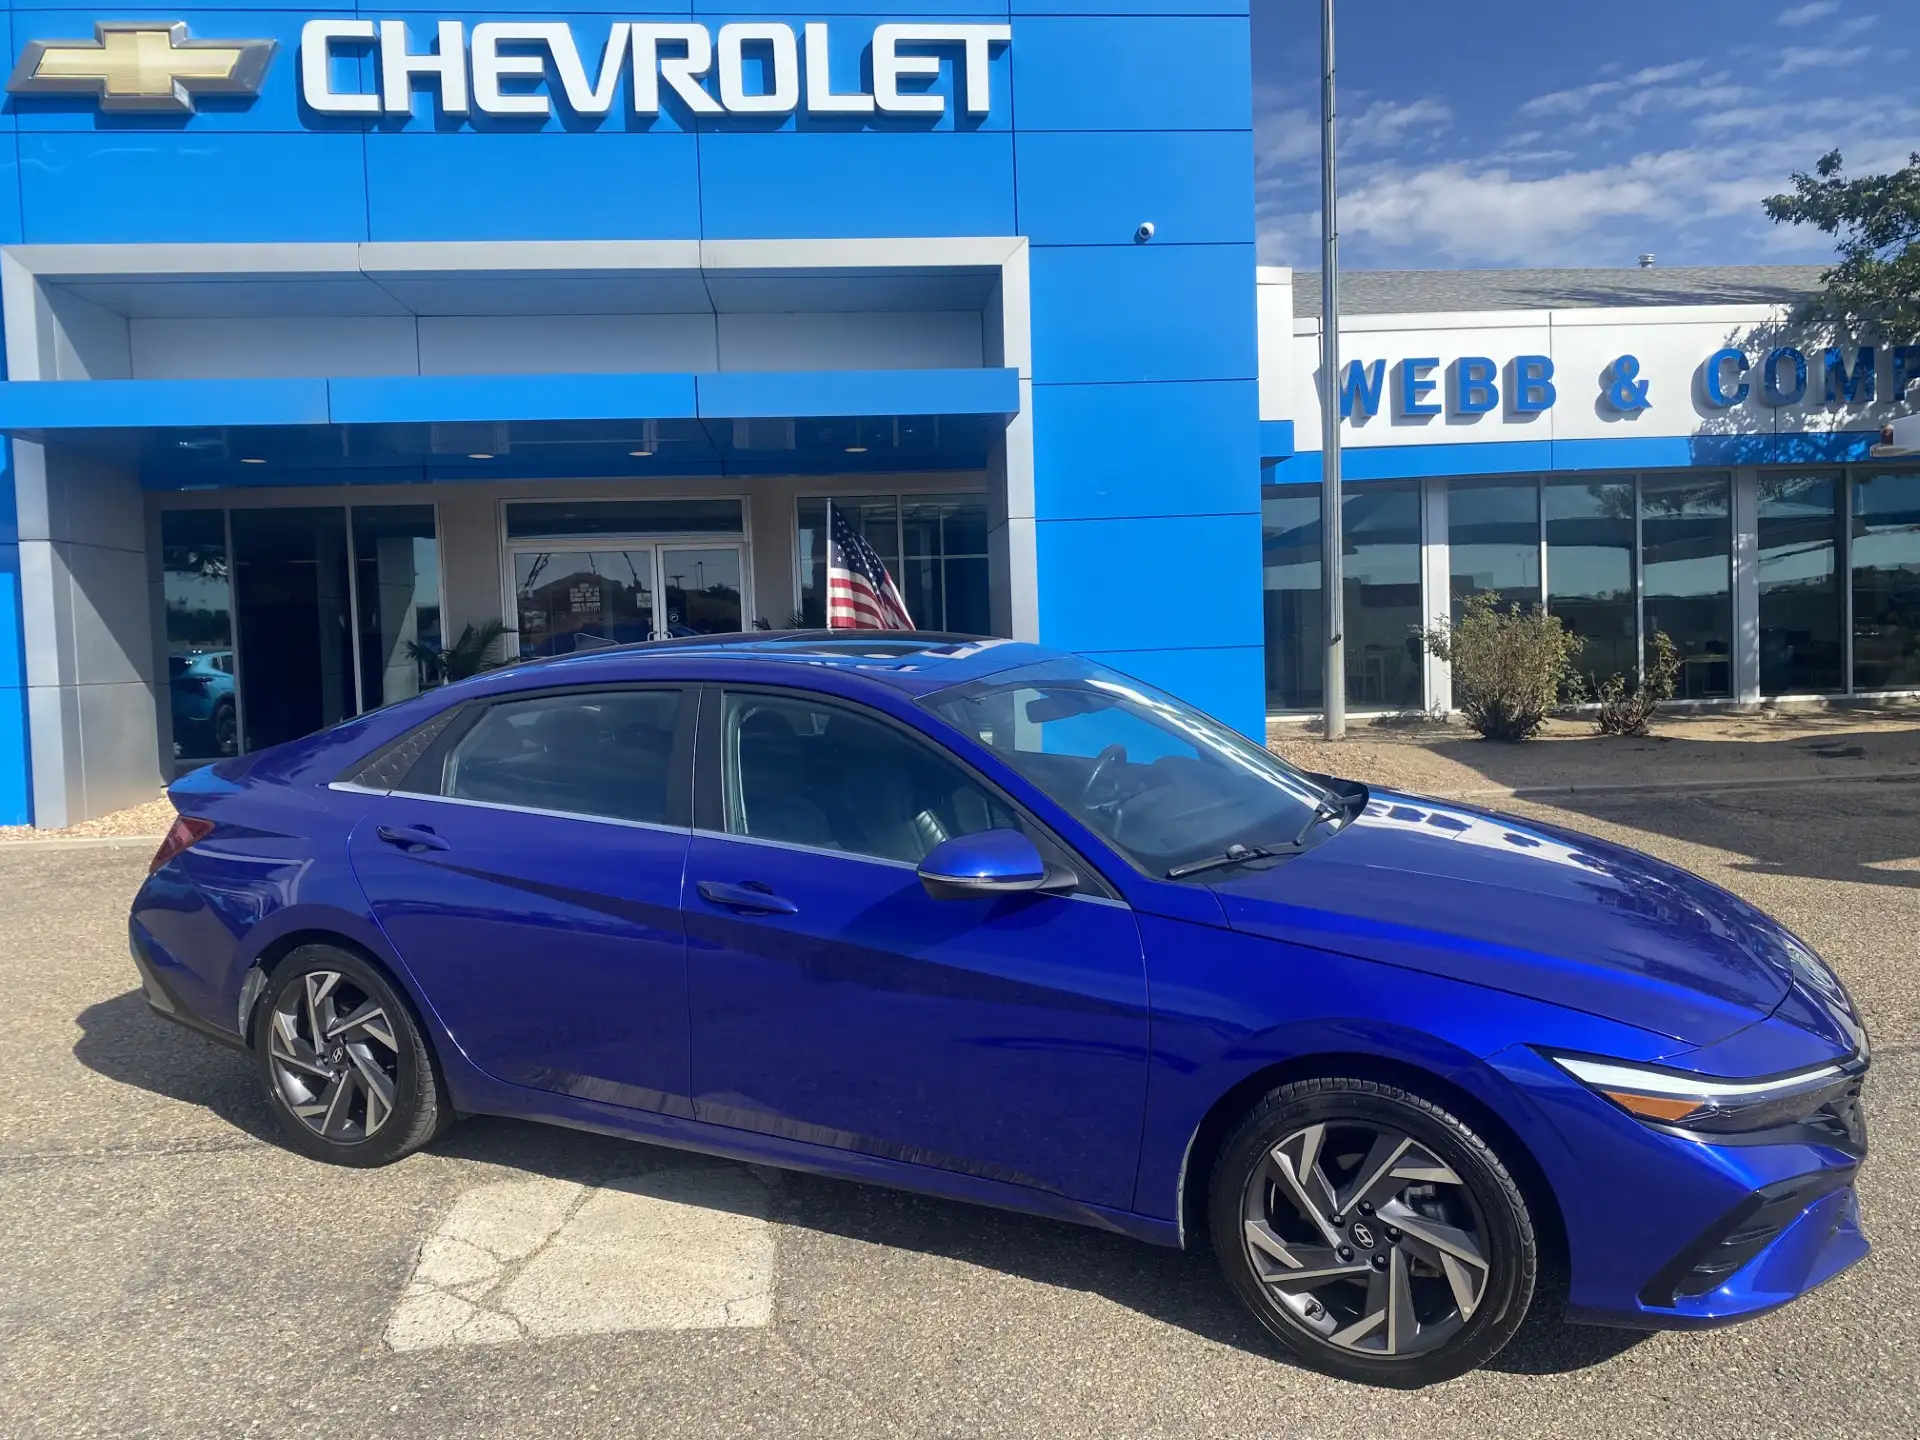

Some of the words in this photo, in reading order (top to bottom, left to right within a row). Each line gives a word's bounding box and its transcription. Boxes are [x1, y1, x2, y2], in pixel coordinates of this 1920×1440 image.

[301, 19, 1012, 114] CHEVROLET
[1338, 354, 1557, 418] WEBB
[1610, 354, 1653, 411] &
